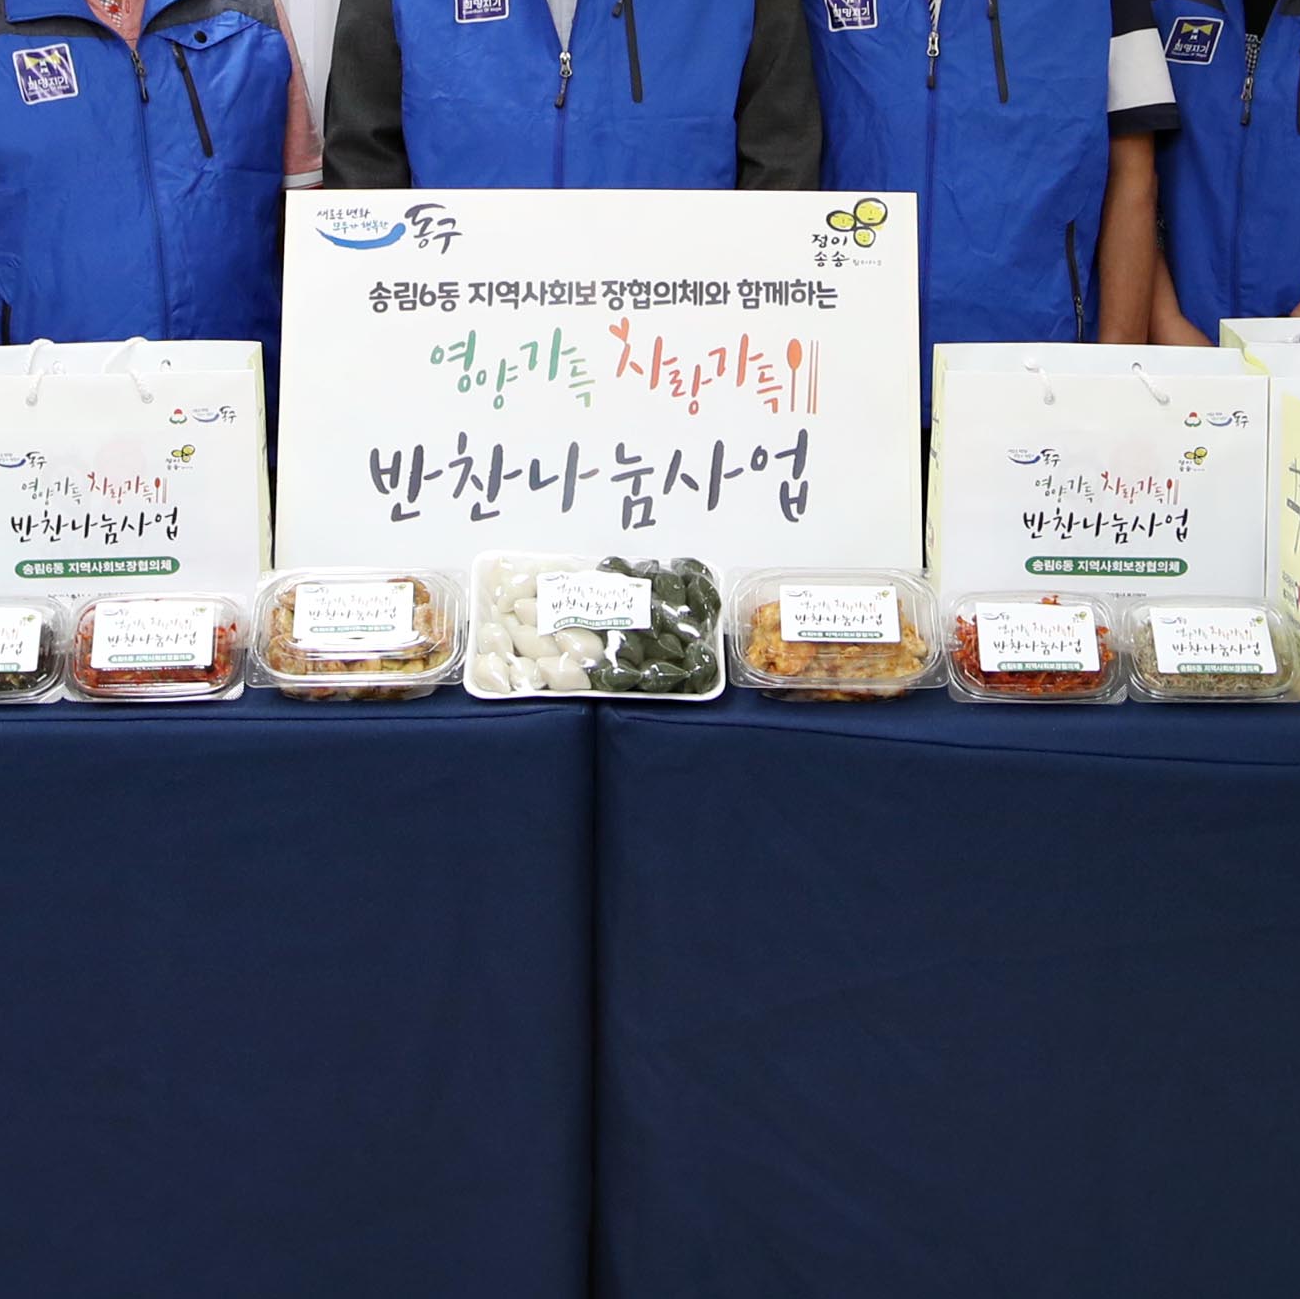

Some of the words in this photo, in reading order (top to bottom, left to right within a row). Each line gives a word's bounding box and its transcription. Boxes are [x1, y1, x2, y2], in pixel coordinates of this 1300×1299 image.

[405, 203, 463, 254] 동구
[368, 280, 458, 313] 송림6동
[737, 279, 839, 311] 함께하는
[430, 328, 595, 409] 영양가득
[609, 317, 783, 416] 사랑가득
[369, 429, 809, 531] 반찬나눔사업
[11, 507, 178, 545] 반찬나눔사업
[1023, 508, 1188, 545] 반찬나눔사업
